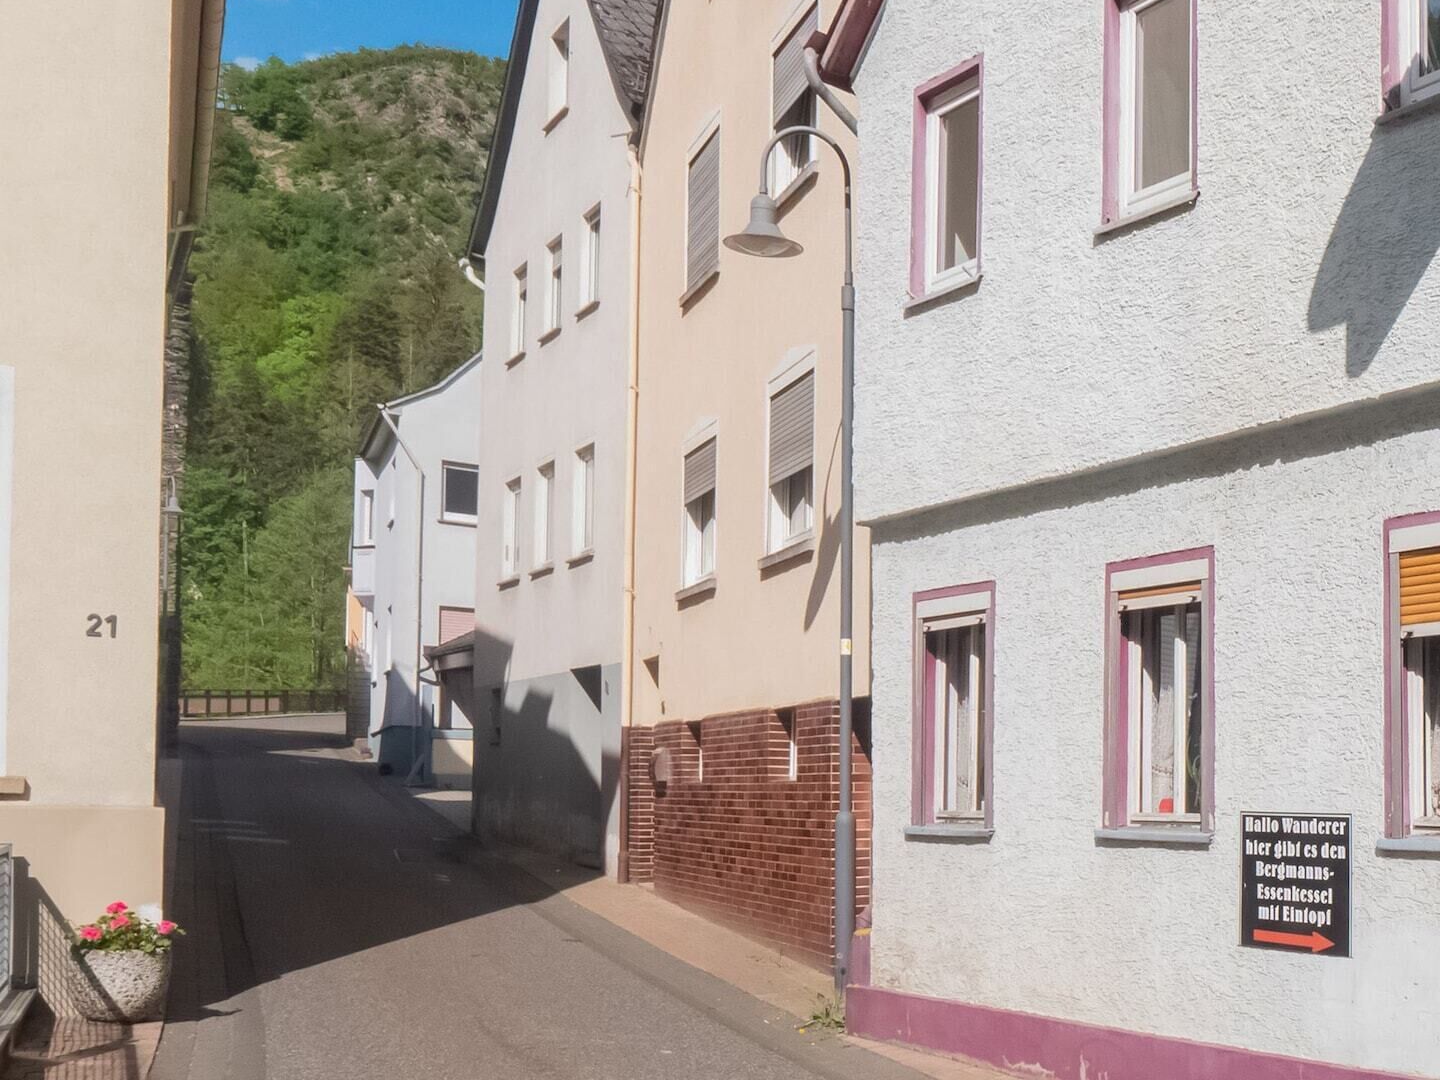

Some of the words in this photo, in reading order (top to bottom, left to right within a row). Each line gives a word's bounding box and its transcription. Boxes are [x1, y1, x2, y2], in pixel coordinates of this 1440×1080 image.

[86, 613, 117, 639] 21
[1245, 816, 1279, 833] Hallo
[1281, 817, 1346, 835] Wanderer
[1245, 839, 1271, 856] hier
[1274, 840, 1301, 859] gibt
[1304, 844, 1318, 858] es
[1321, 842, 1346, 859] den
[1255, 861, 1334, 880] Bergmanns-
[1257, 883, 1333, 904] Essenkessel
[1258, 905, 1279, 921] mit
[1282, 906, 1331, 927] Eintopf
